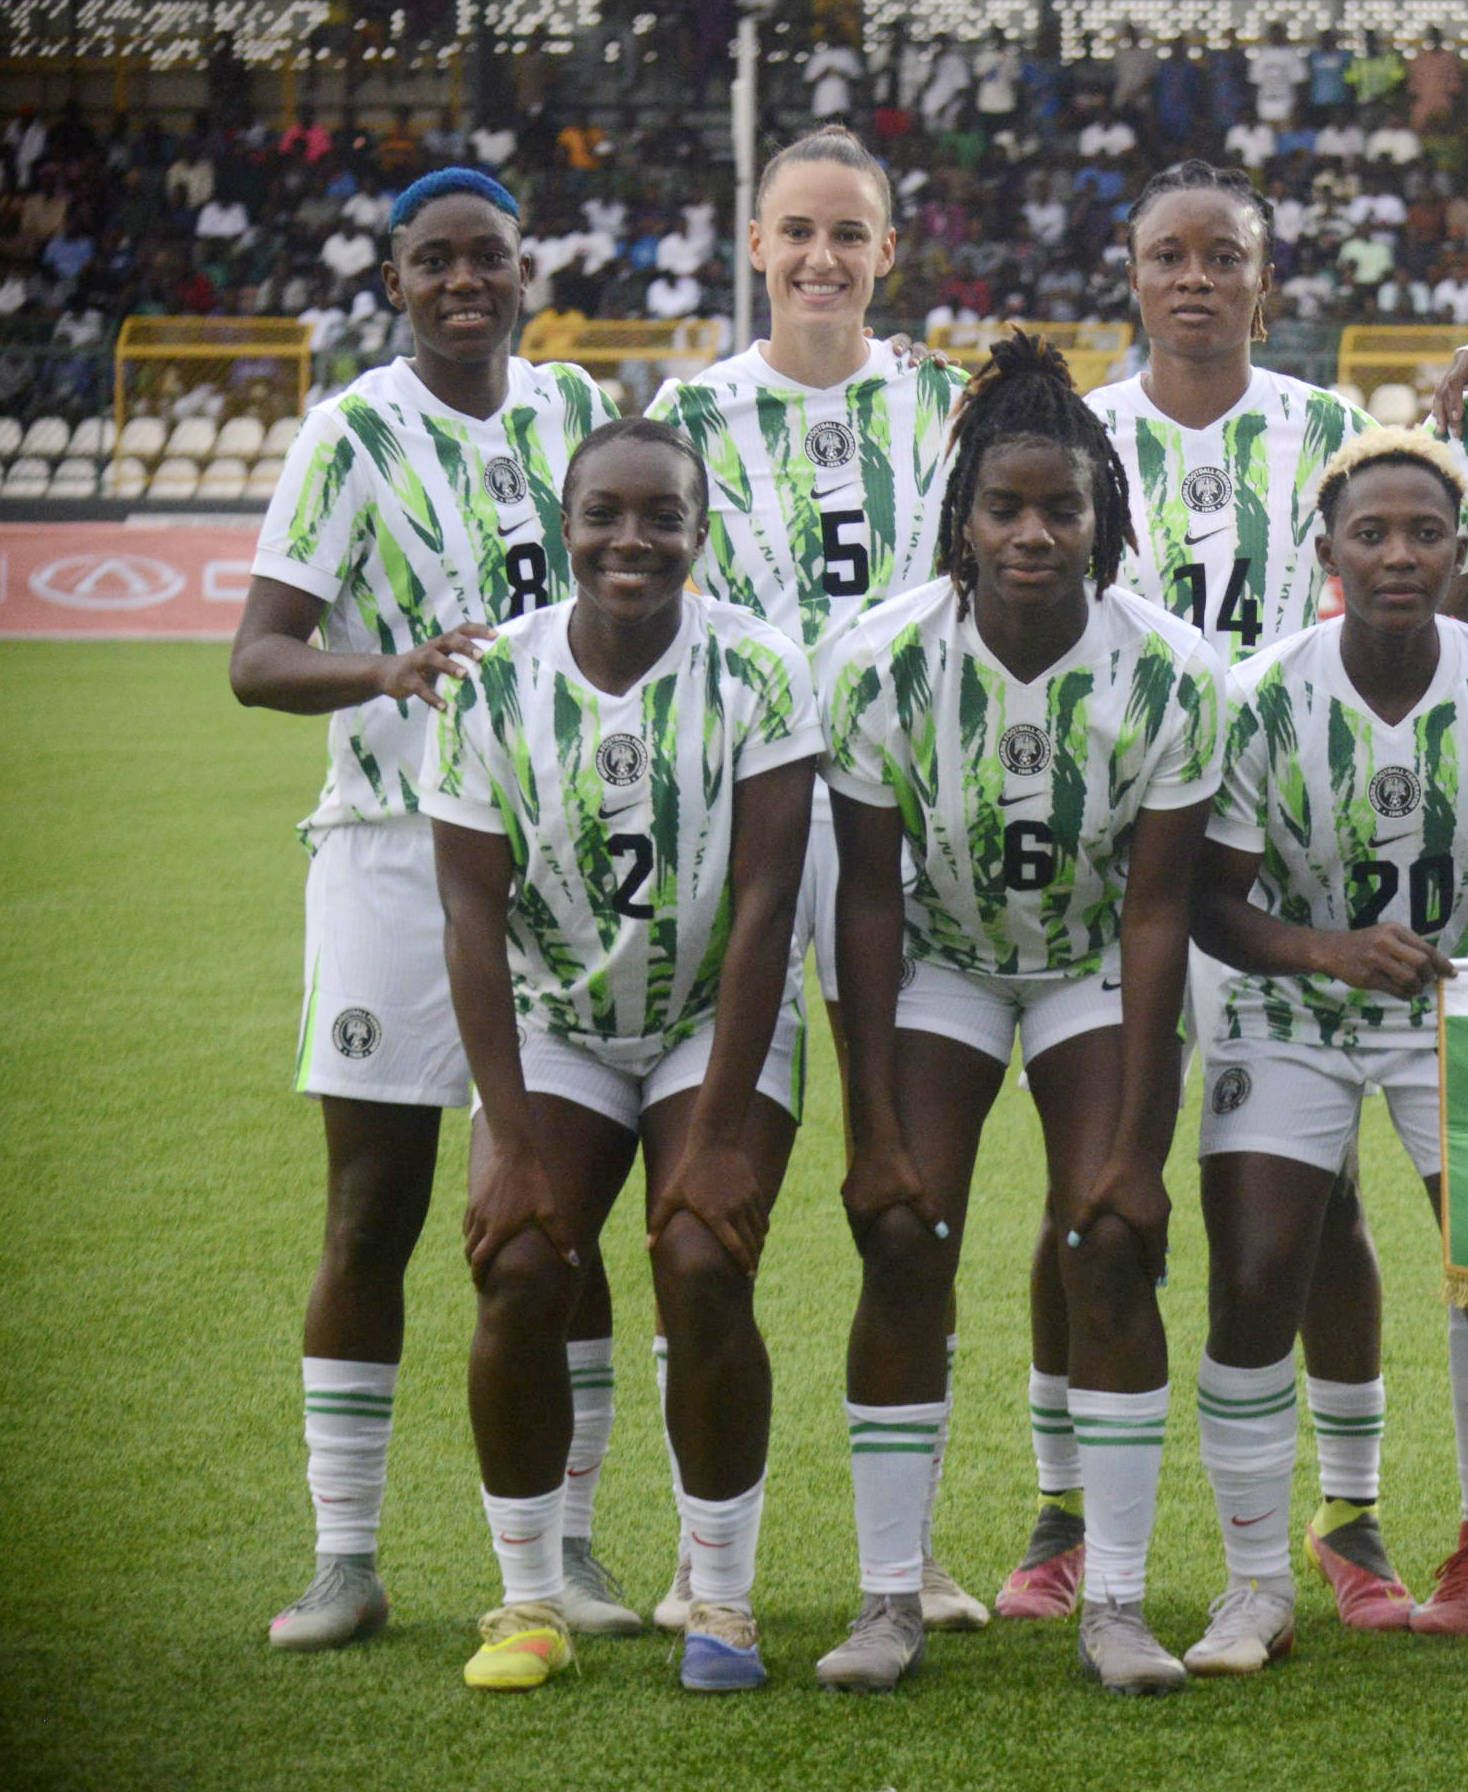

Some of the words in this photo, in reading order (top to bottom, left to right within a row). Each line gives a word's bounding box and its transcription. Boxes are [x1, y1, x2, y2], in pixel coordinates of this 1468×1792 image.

[506, 542, 548, 618] 8
[820, 510, 869, 595] 5
[1173, 557, 1264, 646] 14
[604, 834, 654, 920] 2
[1004, 820, 1055, 892] 6
[1347, 850, 1454, 938] 20
